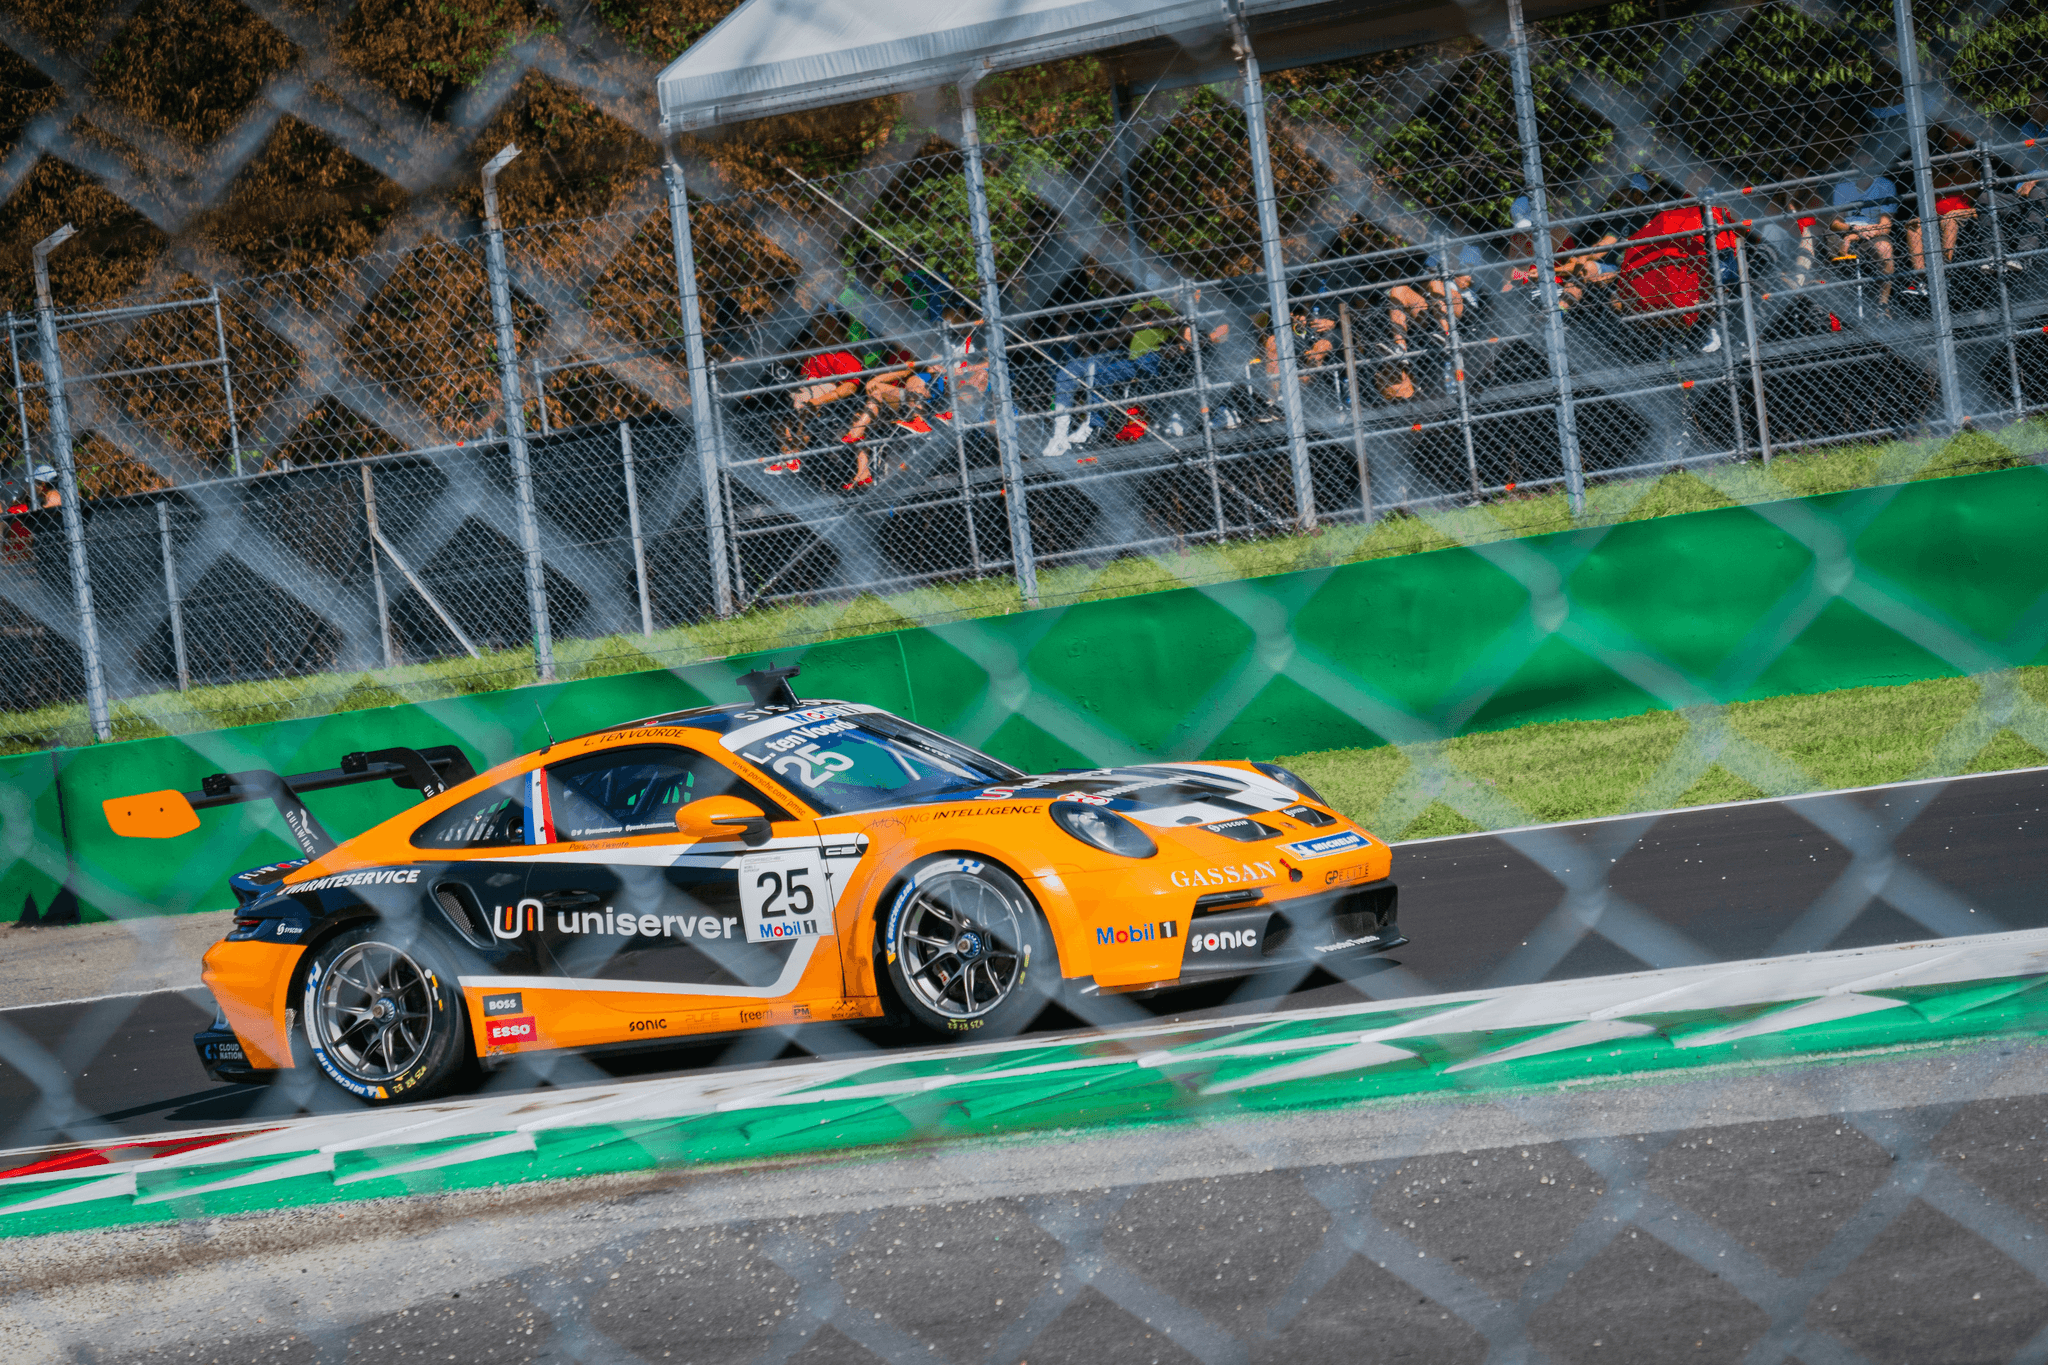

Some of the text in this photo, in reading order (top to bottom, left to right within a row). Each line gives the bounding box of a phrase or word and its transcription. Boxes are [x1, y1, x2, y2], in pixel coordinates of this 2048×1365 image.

[583, 728, 688, 747] L. TEN VOORDE
[742, 751, 777, 765] L.
[764, 734, 808, 752] ten
[772, 743, 855, 789] 25
[732, 759, 807, 817] www.porsche.com/pmsc
[871, 805, 1044, 829] MOVING INTELLIGENCE
[1218, 819, 1250, 830] SYSCOIN
[285, 810, 315, 854] GULLWING
[1310, 834, 1361, 852] MICHELIN
[1170, 860, 1277, 888] GASSAN
[757, 867, 814, 919] 25
[557, 906, 738, 940] uniserver
[759, 920, 802, 938] Mobil
[1096, 923, 1156, 946] Mobil
[488, 998, 517, 1011] BOSS
[793, 1007, 811, 1016] PM
[739, 1008, 773, 1024] freem
[492, 1024, 531, 1039] ESSO
[219, 1043, 240, 1052] CLOUD
[219, 1051, 243, 1060] NATION
[316, 1051, 367, 1095] MICHELIN
